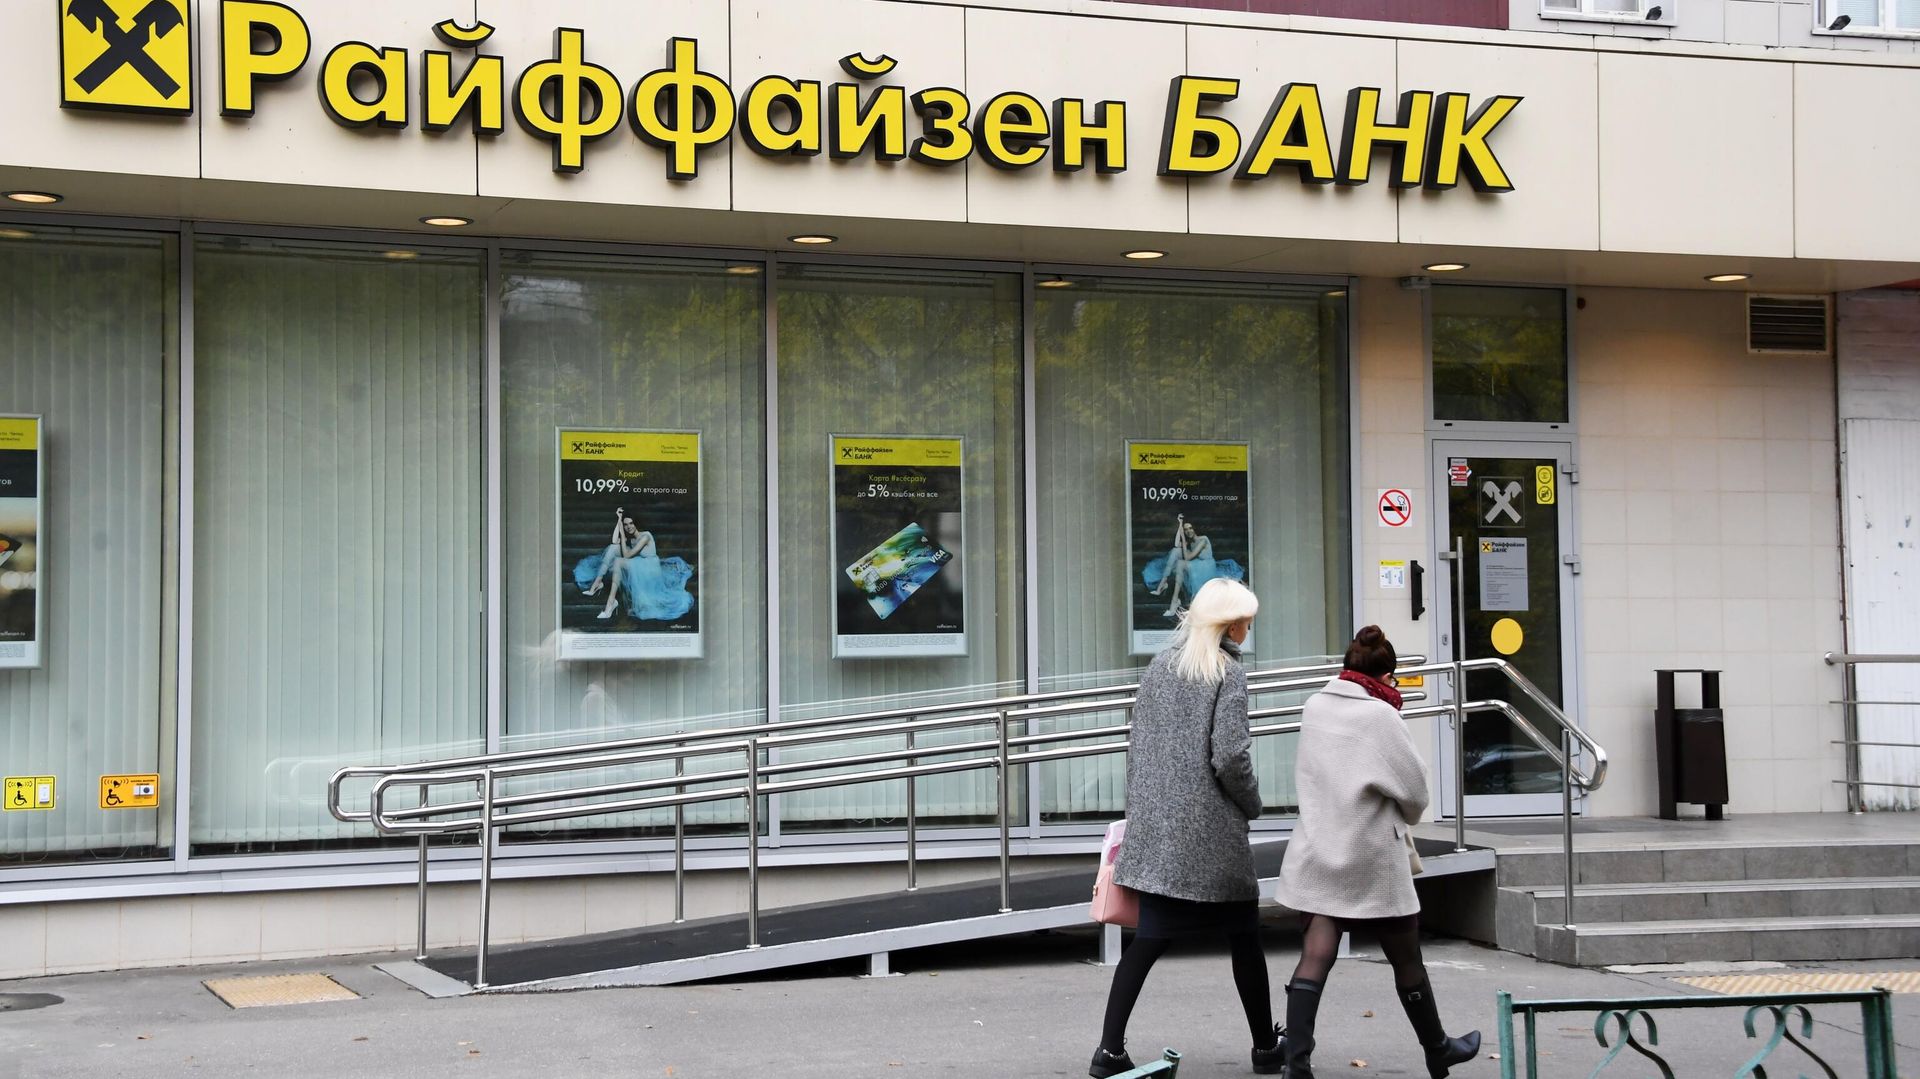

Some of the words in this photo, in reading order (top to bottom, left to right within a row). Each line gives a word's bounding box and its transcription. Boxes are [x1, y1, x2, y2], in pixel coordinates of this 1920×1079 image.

[220, 0, 1127, 181] Райффайзен
[1157, 75, 1524, 194] БАНК
[585, 441, 626, 449] Райффайзен
[618, 470, 645, 478] Кредит
[868, 474, 890, 482] Карта
[575, 478, 630, 494] 10,99%
[671, 487, 688, 495] года
[1178, 479, 1201, 487] Кредит
[867, 484, 890, 497] 5%
[1142, 487, 1188, 502] 10,99%
[930, 550, 946, 563] VISA
